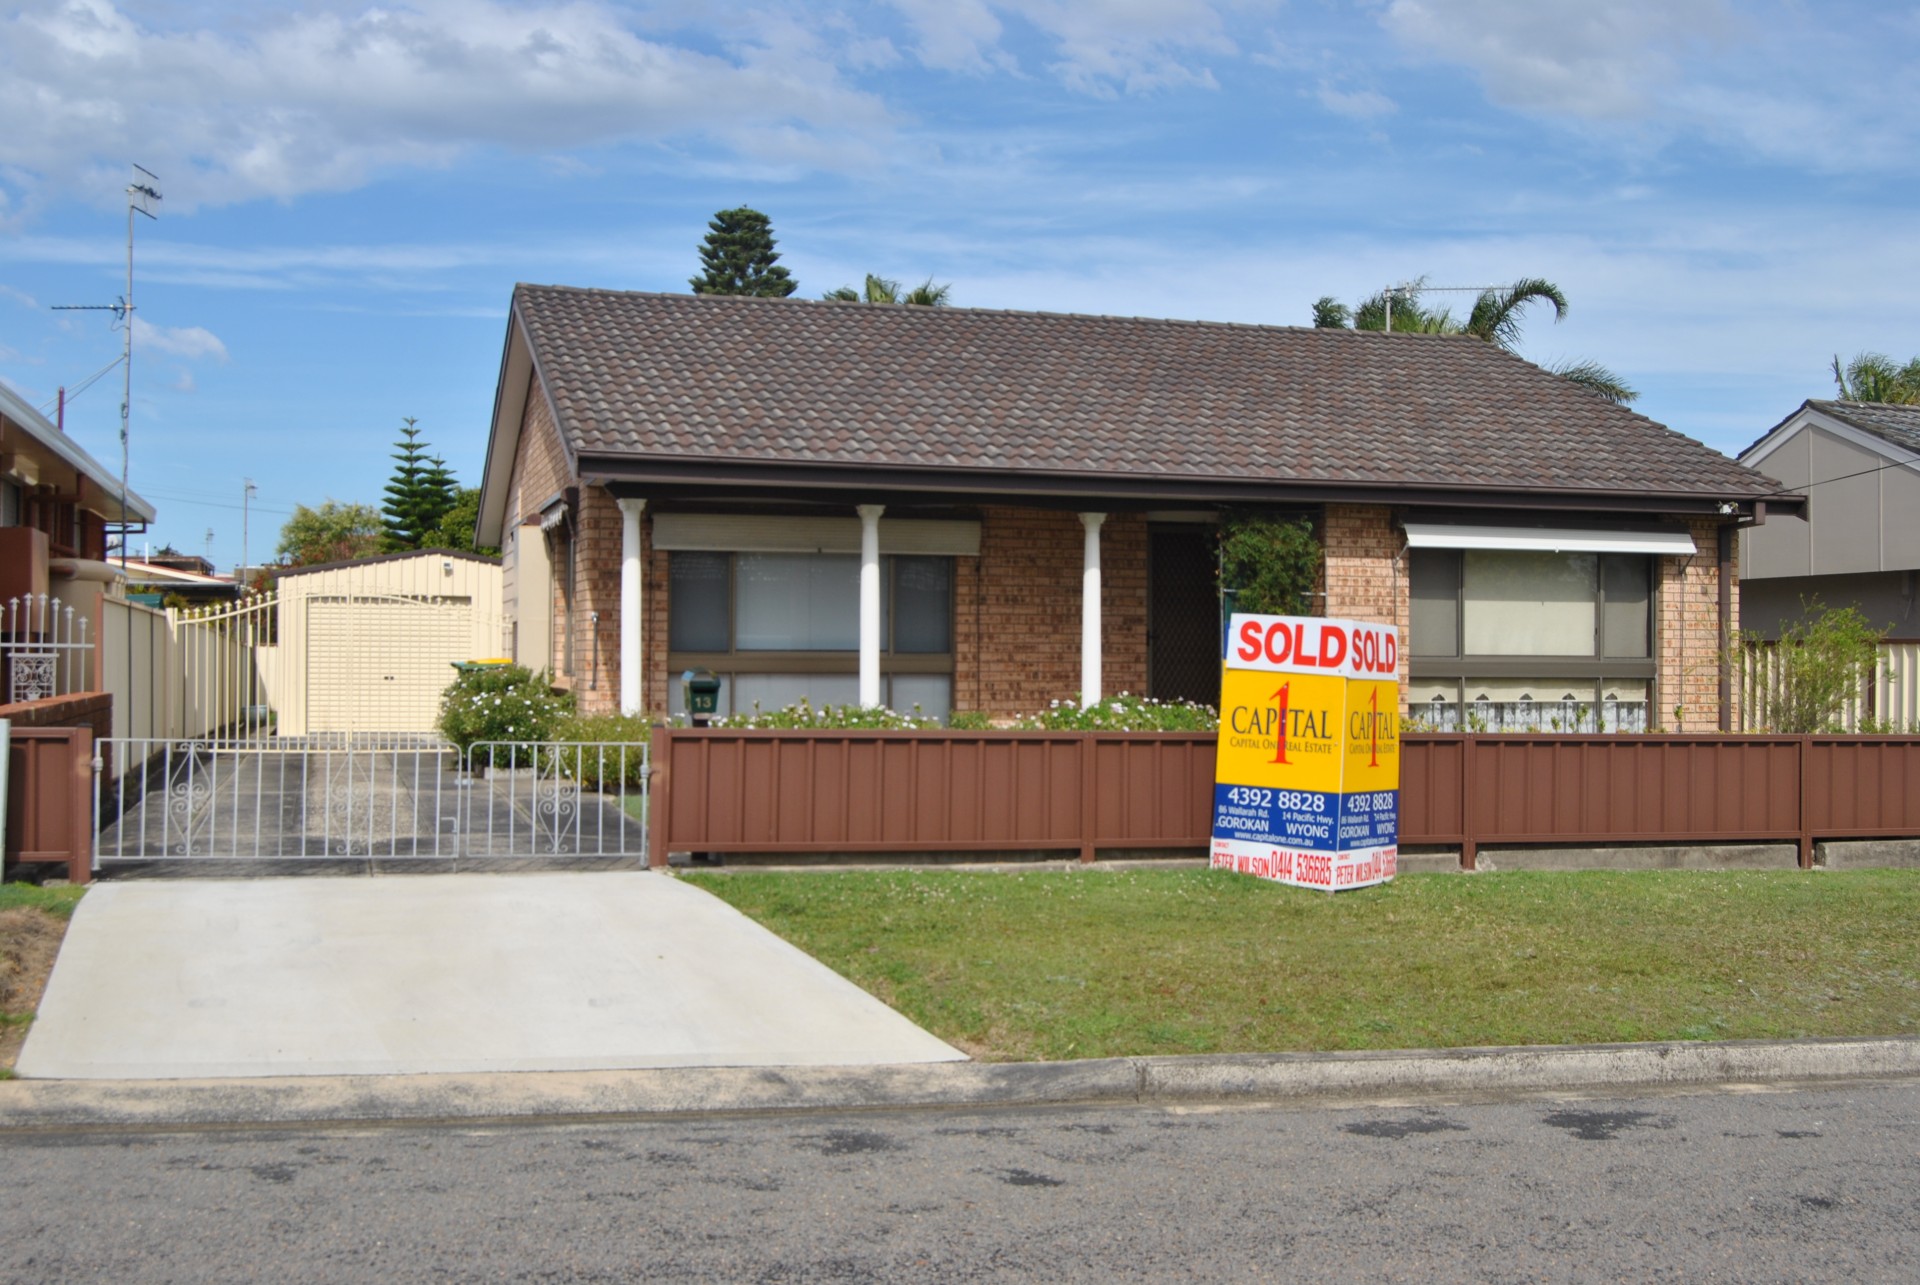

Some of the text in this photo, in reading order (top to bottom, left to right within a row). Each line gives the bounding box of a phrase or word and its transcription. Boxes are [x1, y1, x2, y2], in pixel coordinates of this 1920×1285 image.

[1237, 620, 1347, 668] SOLD
[1352, 628, 1396, 673] SOLD
[695, 697, 712, 708] 13
[1231, 705, 1333, 740] CAPITAL
[1350, 710, 1395, 740] CAPITAL
[1228, 787, 1325, 812] 4392 8828
[1347, 792, 1393, 813] 4392 8828
[1218, 804, 1228, 815] 86
[1228, 806, 1257, 817] Wallarah
[1282, 811, 1335, 826] 14 Pacific Hwy.
[1218, 815, 1269, 832] GOROKAN
[1286, 822, 1329, 838] WYONG
[1340, 824, 1370, 839] GOROKAN
[1376, 821, 1395, 835] WYONG
[1234, 831, 1314, 847] www.capitalone.com.au
[1237, 855, 1270, 878] WILSON
[1271, 850, 1293, 880] 0414
[1296, 853, 1332, 885] 536685
[1336, 864, 1354, 885] PETER
